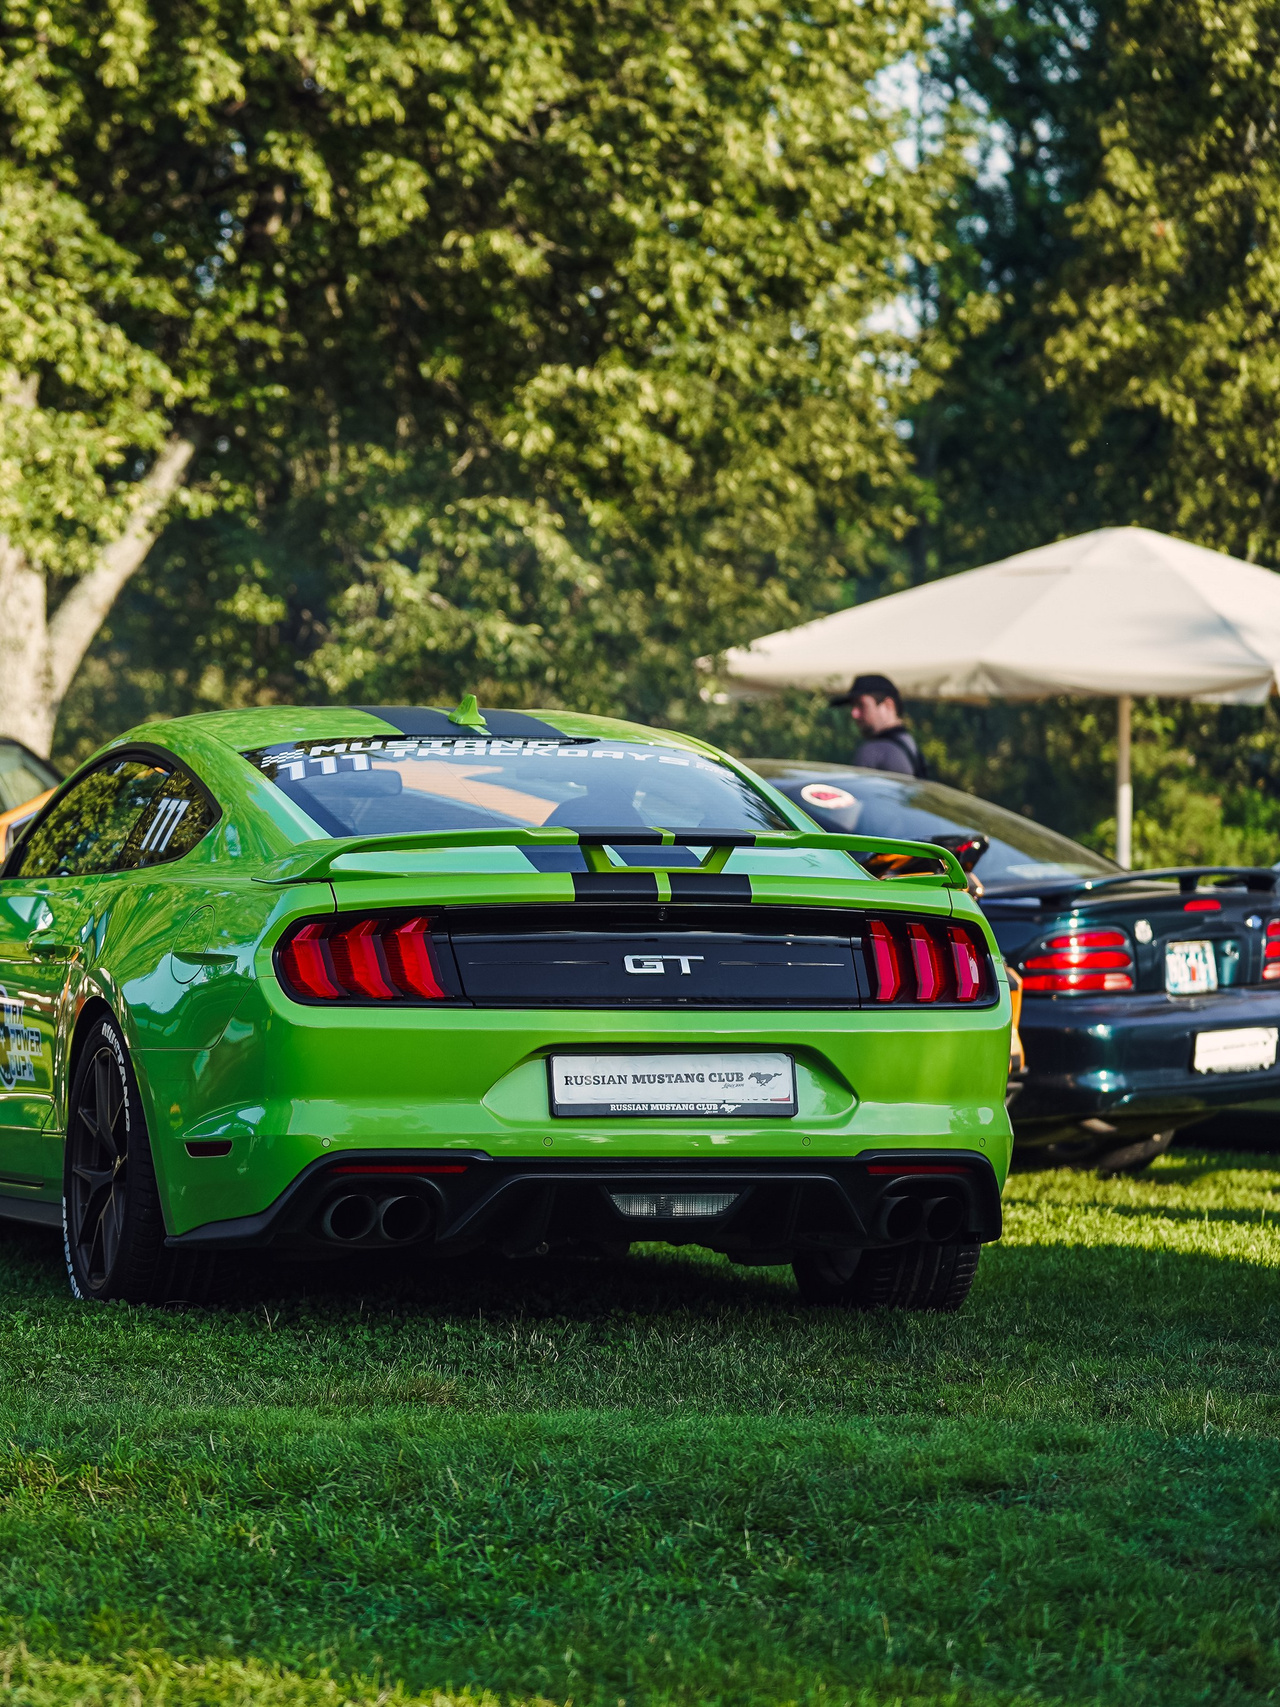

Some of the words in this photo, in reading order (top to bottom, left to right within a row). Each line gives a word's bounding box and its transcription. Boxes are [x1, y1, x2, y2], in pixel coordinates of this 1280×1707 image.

[309, 739, 560, 756] MUSTANG
[384, 747, 689, 766] TRACKDAYS
[277, 753, 370, 781] 111
[139, 797, 191, 853] 111
[623, 954, 705, 976] GT
[9, 1027, 42, 1053] POWER
[563, 1074, 629, 1086] RUSSIAN
[631, 1073, 705, 1085] MUSTANG
[708, 1072, 745, 1083] CLUB
[609, 1103, 649, 1111] RUSSIAN
[650, 1103, 694, 1111] MUSTANG
